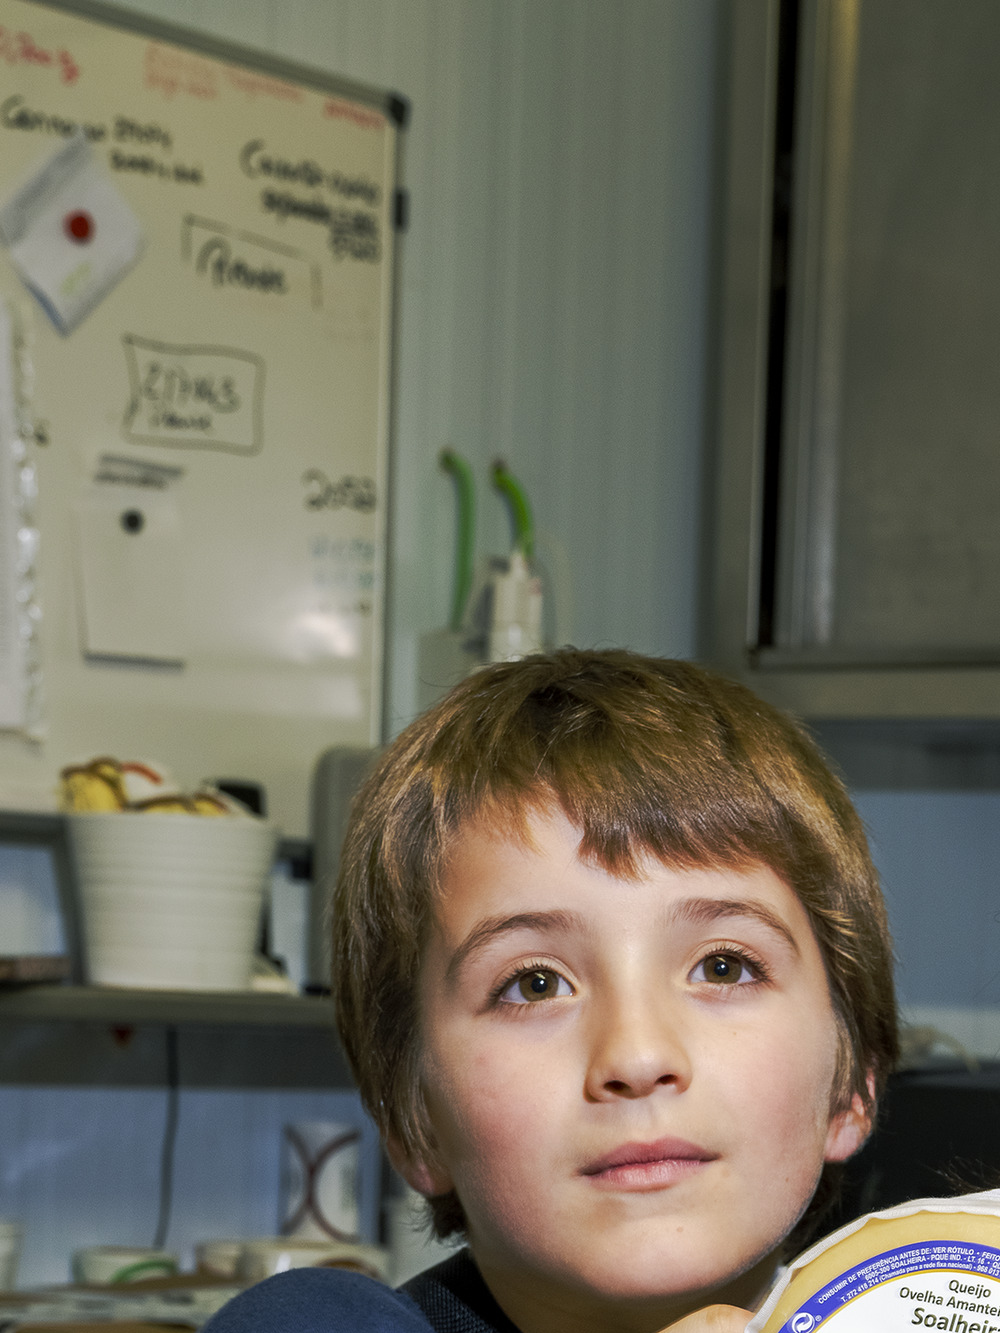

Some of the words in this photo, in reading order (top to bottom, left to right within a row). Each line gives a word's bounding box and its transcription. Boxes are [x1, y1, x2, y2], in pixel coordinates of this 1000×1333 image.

[891, 1255, 927, 1270] SOALHEIRA
[930, 1253, 949, 1261] PQUE
[982, 1252, 1000, 1261] FEITO
[818, 1280, 848, 1304] CONSUMIR
[847, 1274, 858, 1284] DE
[857, 1255, 899, 1278] PREFERÊNCIA
[900, 1249, 920, 1260] ANTES
[920, 1247, 932, 1255] DE:
[932, 1246, 946, 1254] VER
[947, 1246, 974, 1256] RÓTULO
[847, 1289, 858, 1300] 272
[868, 1277, 879, 1287] 214
[906, 1265, 918, 1274] para
[947, 1261, 973, 1271] nacional)
[899, 1286, 944, 1306] Ovelha
[948, 1279, 992, 1299] Queijo
